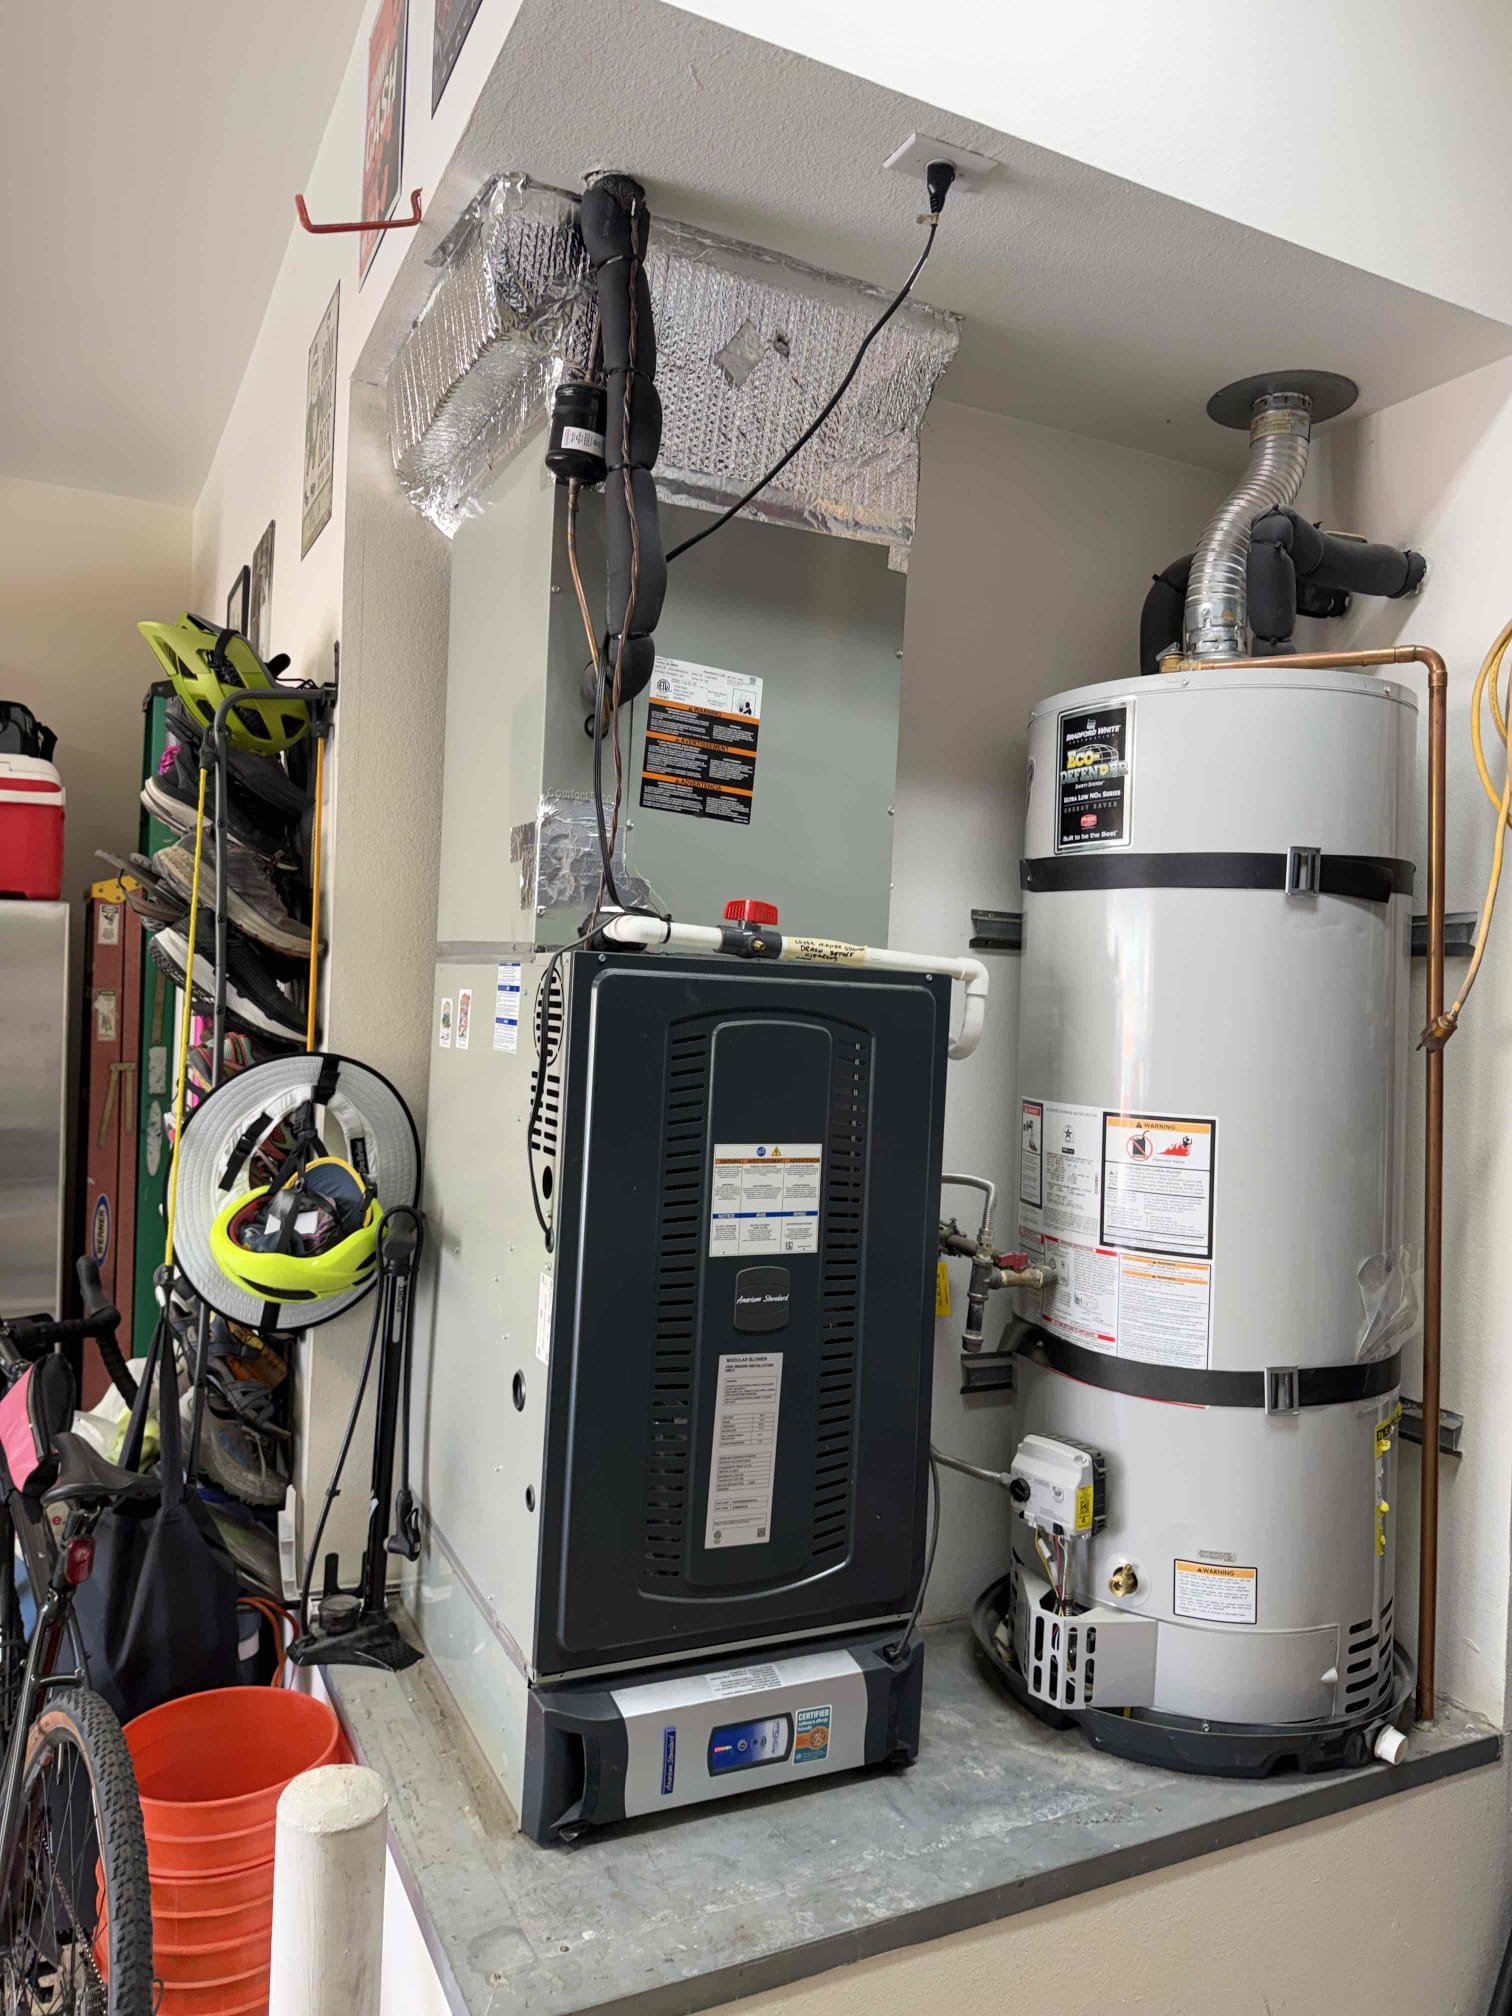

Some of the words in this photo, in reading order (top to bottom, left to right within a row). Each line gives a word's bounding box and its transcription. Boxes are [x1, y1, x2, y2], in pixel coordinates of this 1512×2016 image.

[1066, 729, 1097, 742] BRADFORD
[1097, 725, 1121, 735] WHITE
[1067, 750, 1100, 769] ECO-
[1060, 760, 1129, 784] DEFENDER
[1102, 789, 1121, 798] SERIES
[1144, 1122, 1176, 1131] WARNING
[96, 1209, 104, 1255] WERNER
[1203, 1567, 1235, 1577] WARNING
[798, 1708, 830, 1721] CERTIFIED
